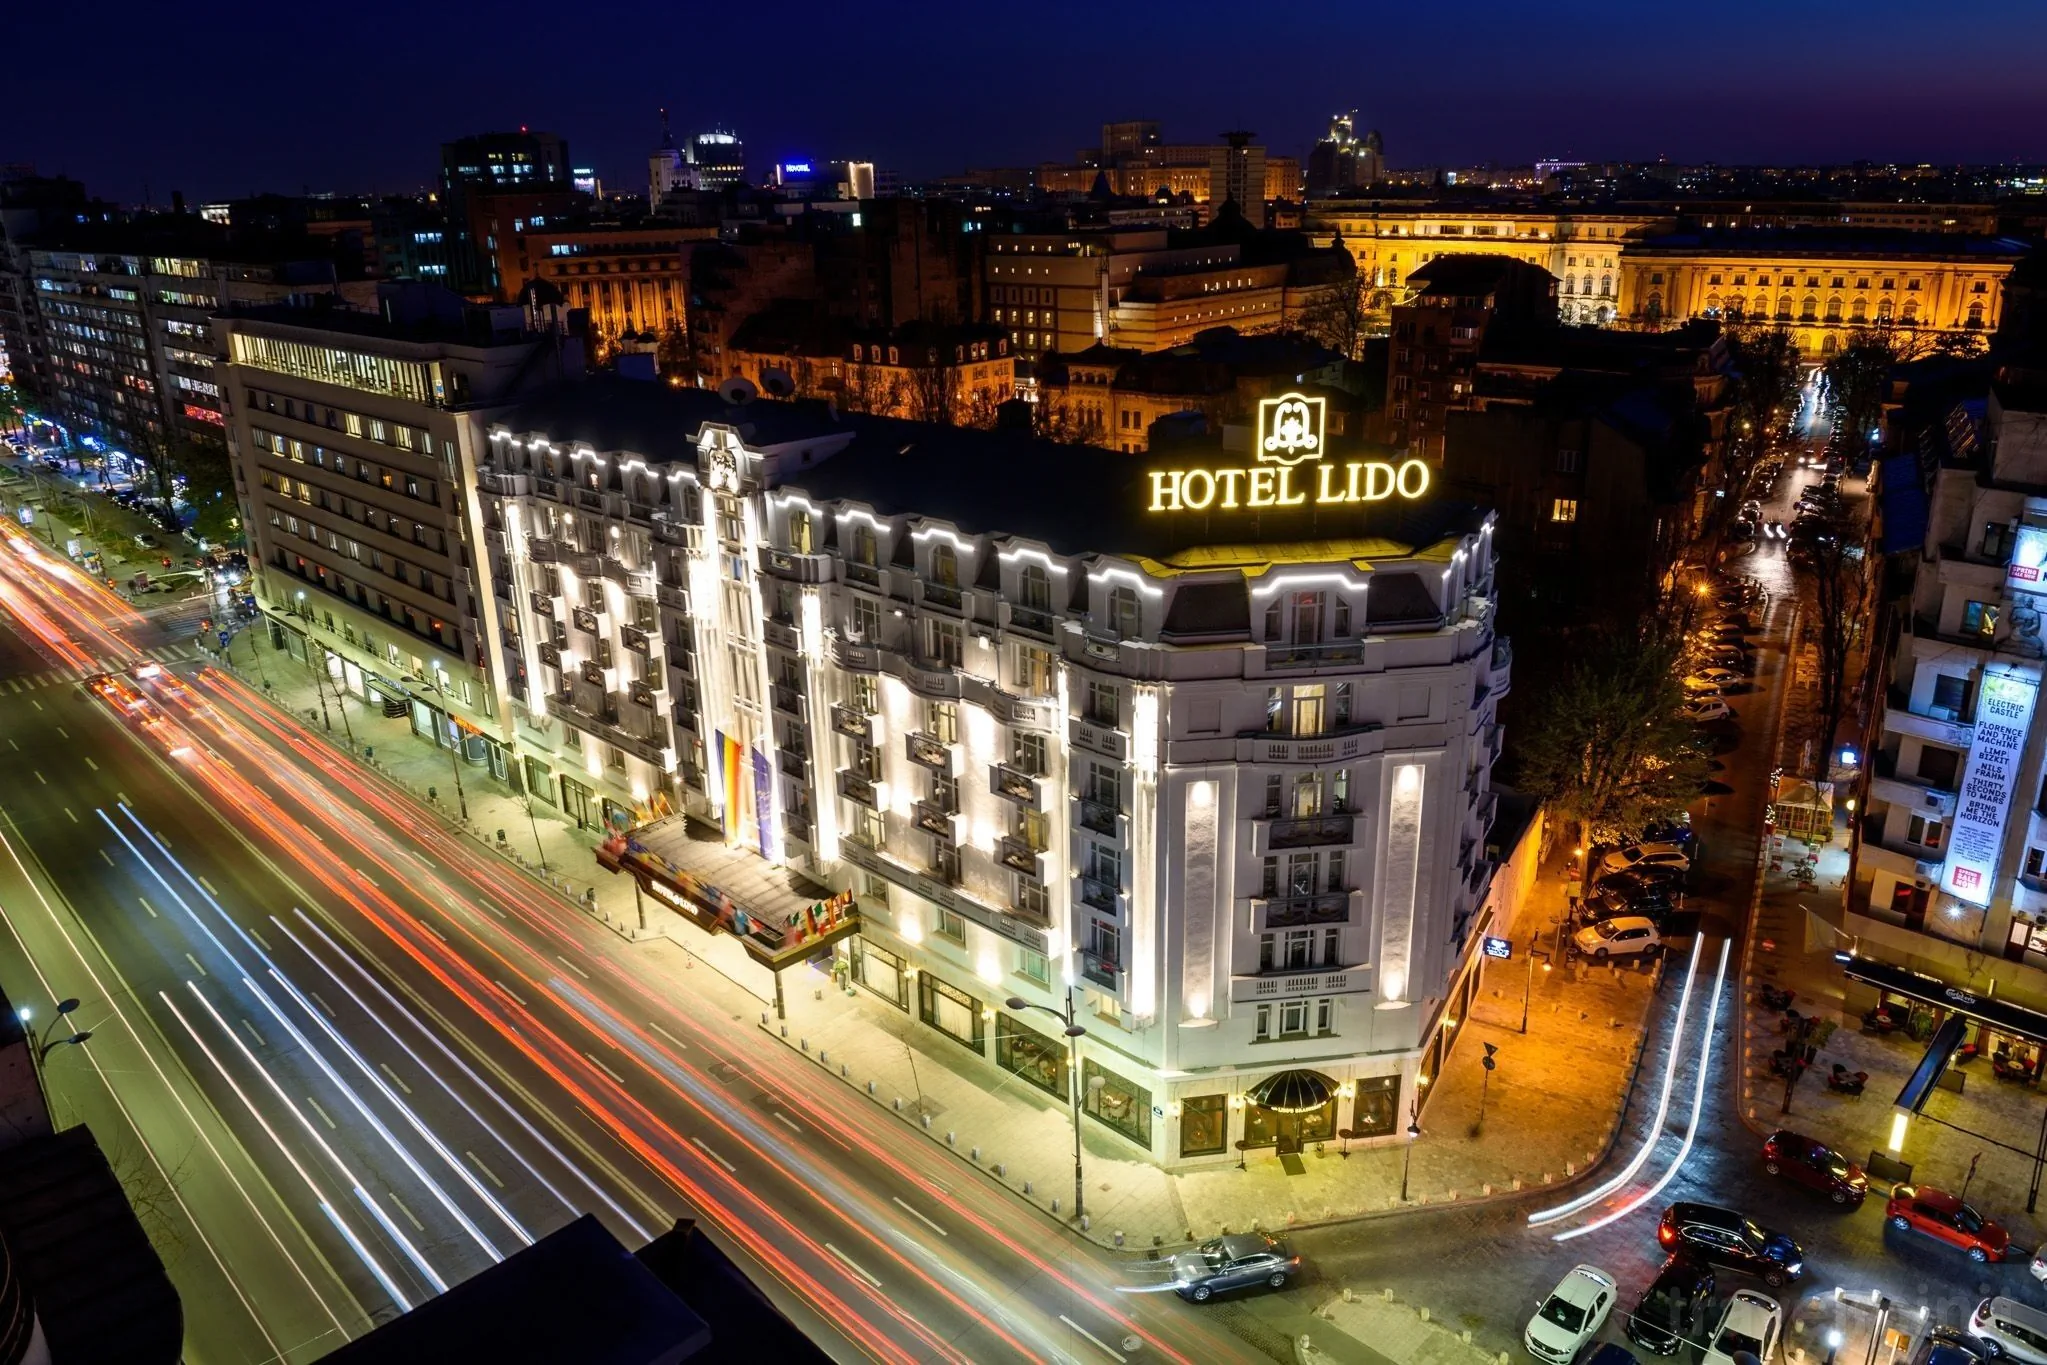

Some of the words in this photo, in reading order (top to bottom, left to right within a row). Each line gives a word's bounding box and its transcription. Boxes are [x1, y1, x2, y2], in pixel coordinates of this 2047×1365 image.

[1148, 466, 1305, 511] HOTEL
[1316, 459, 1430, 504] LIDO
[1988, 698, 2024, 713] ELECTRIC
[1989, 706, 2019, 719] CASTLE
[1978, 720, 2023, 737] FLORENCE
[1977, 735, 2019, 750] MACHINE
[1980, 729, 1999, 738] AND
[2002, 733, 2018, 743] THE
[1978, 752, 2010, 765] BIZKIT
[1984, 746, 2007, 757] LIMP
[1975, 768, 2006, 781] FRAHM
[1980, 762, 2003, 774] NILS
[1966, 782, 2007, 799] SECONDS
[1972, 777, 2004, 791] THIRTY
[1966, 789, 1977, 798] TO
[1979, 794, 2005, 805] MARS
[1965, 806, 1979, 815] ME
[1981, 810, 1998, 820] THE
[1969, 800, 1997, 813] BRING
[1960, 811, 2000, 828] HORIZON
[1957, 872, 1977, 884] SALE
